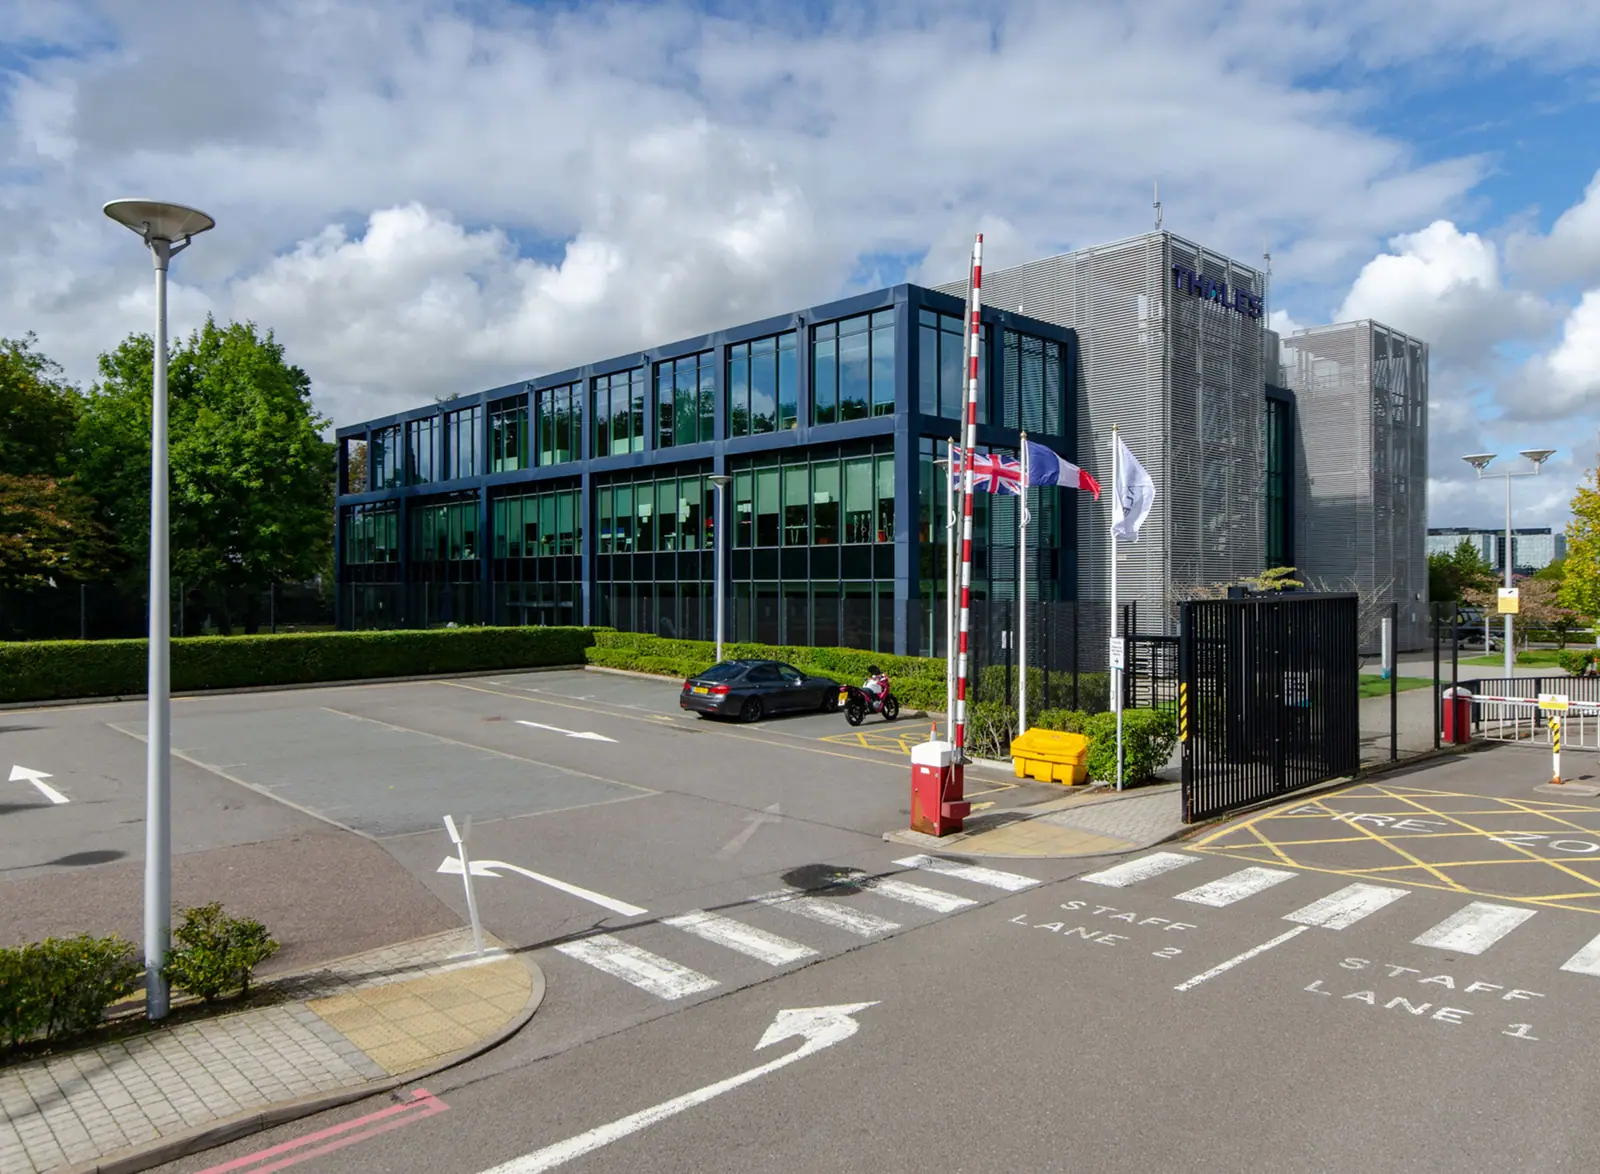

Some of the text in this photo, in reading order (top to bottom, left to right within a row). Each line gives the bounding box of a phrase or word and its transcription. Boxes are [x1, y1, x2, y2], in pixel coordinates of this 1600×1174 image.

[1172, 263, 1264, 319] THALES
[1288, 806, 1448, 833] FIRE
[1008, 914, 1183, 959] LANE 2
[1060, 900, 1198, 932] STAFF
[1338, 957, 1546, 1001] STAFF
[1303, 979, 1541, 1041] LANE 1
